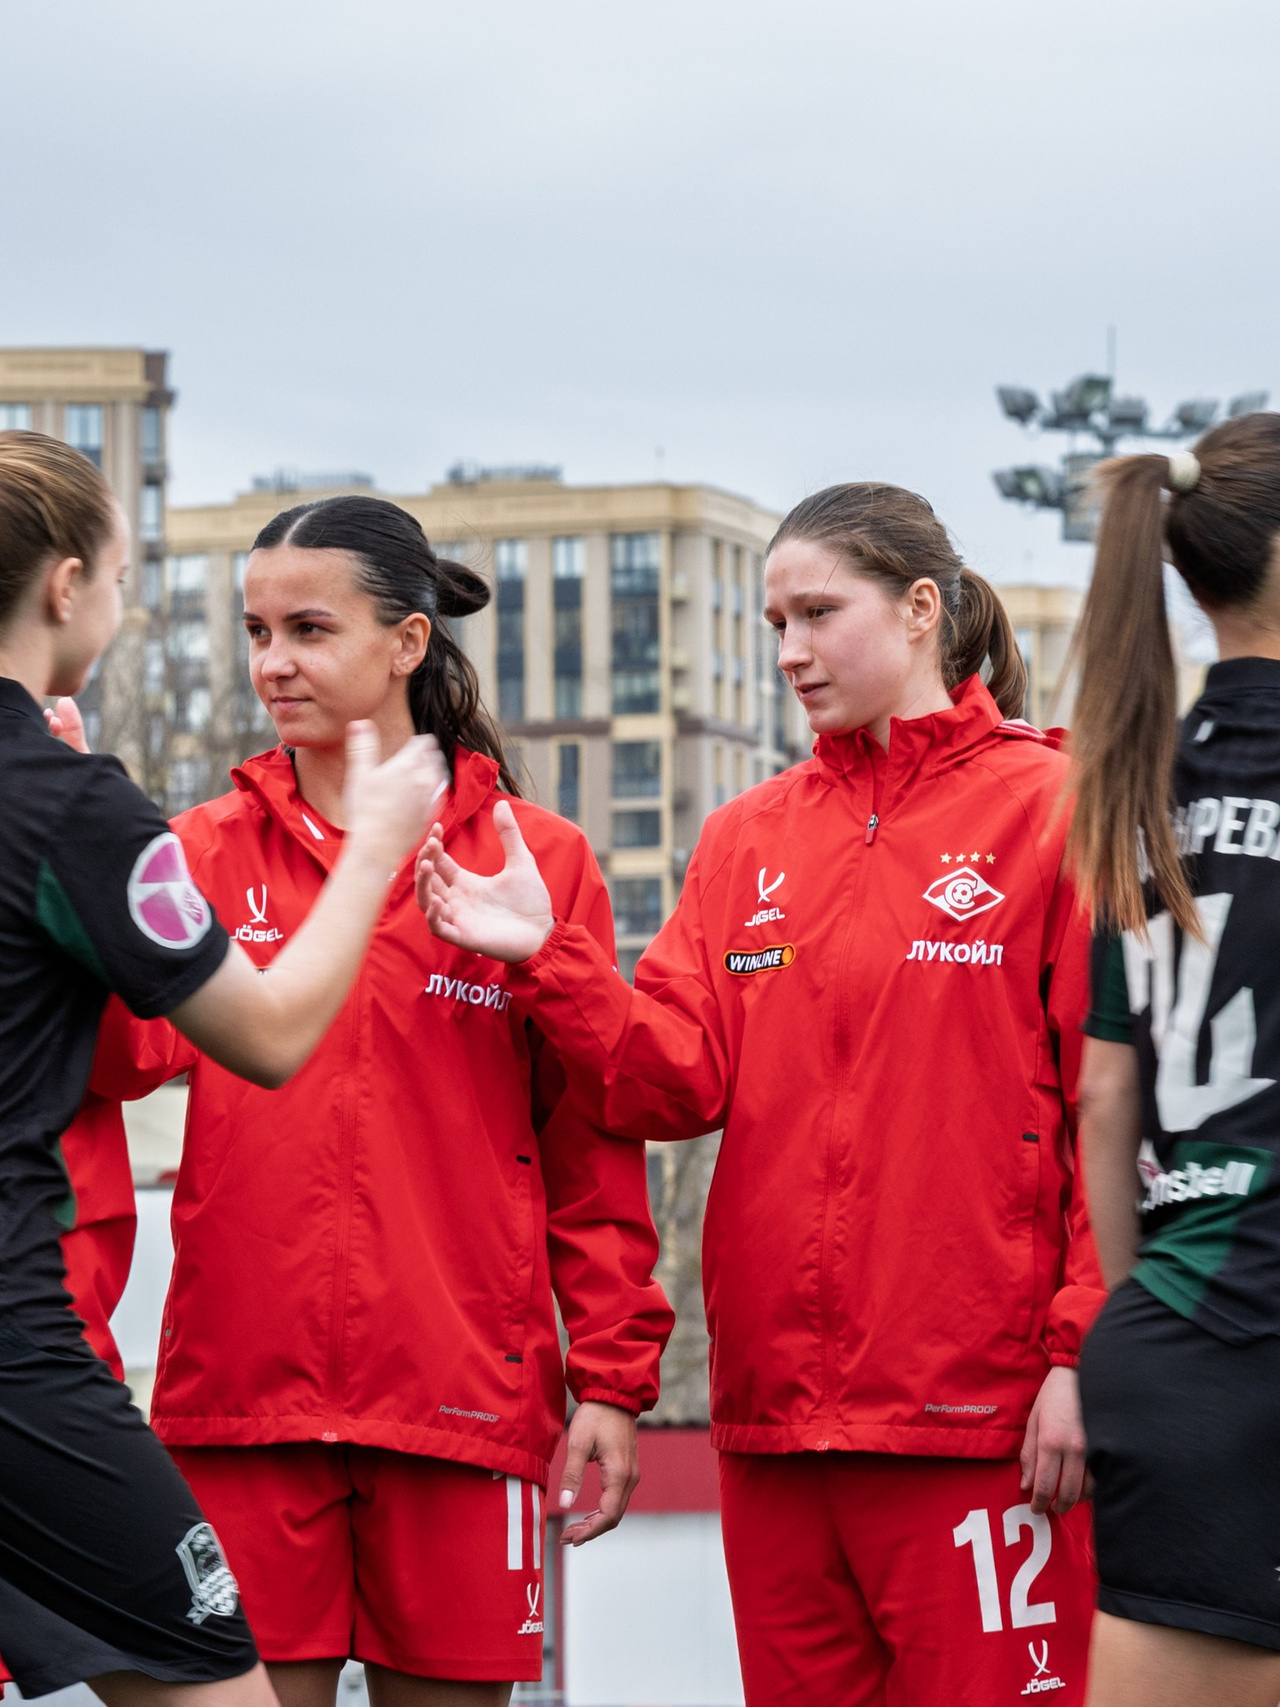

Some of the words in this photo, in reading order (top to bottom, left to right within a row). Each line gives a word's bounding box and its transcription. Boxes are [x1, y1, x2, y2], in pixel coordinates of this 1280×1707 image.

[229, 923, 284, 942] JÖGEL
[730, 949, 783, 972] WINLINE
[906, 939, 1004, 966] ЛУКОЙЛ
[424, 973, 514, 1013] ЛУКОЙЛ
[953, 1503, 1057, 1633] 12
[1020, 1676, 1066, 1695] JÖGEL
